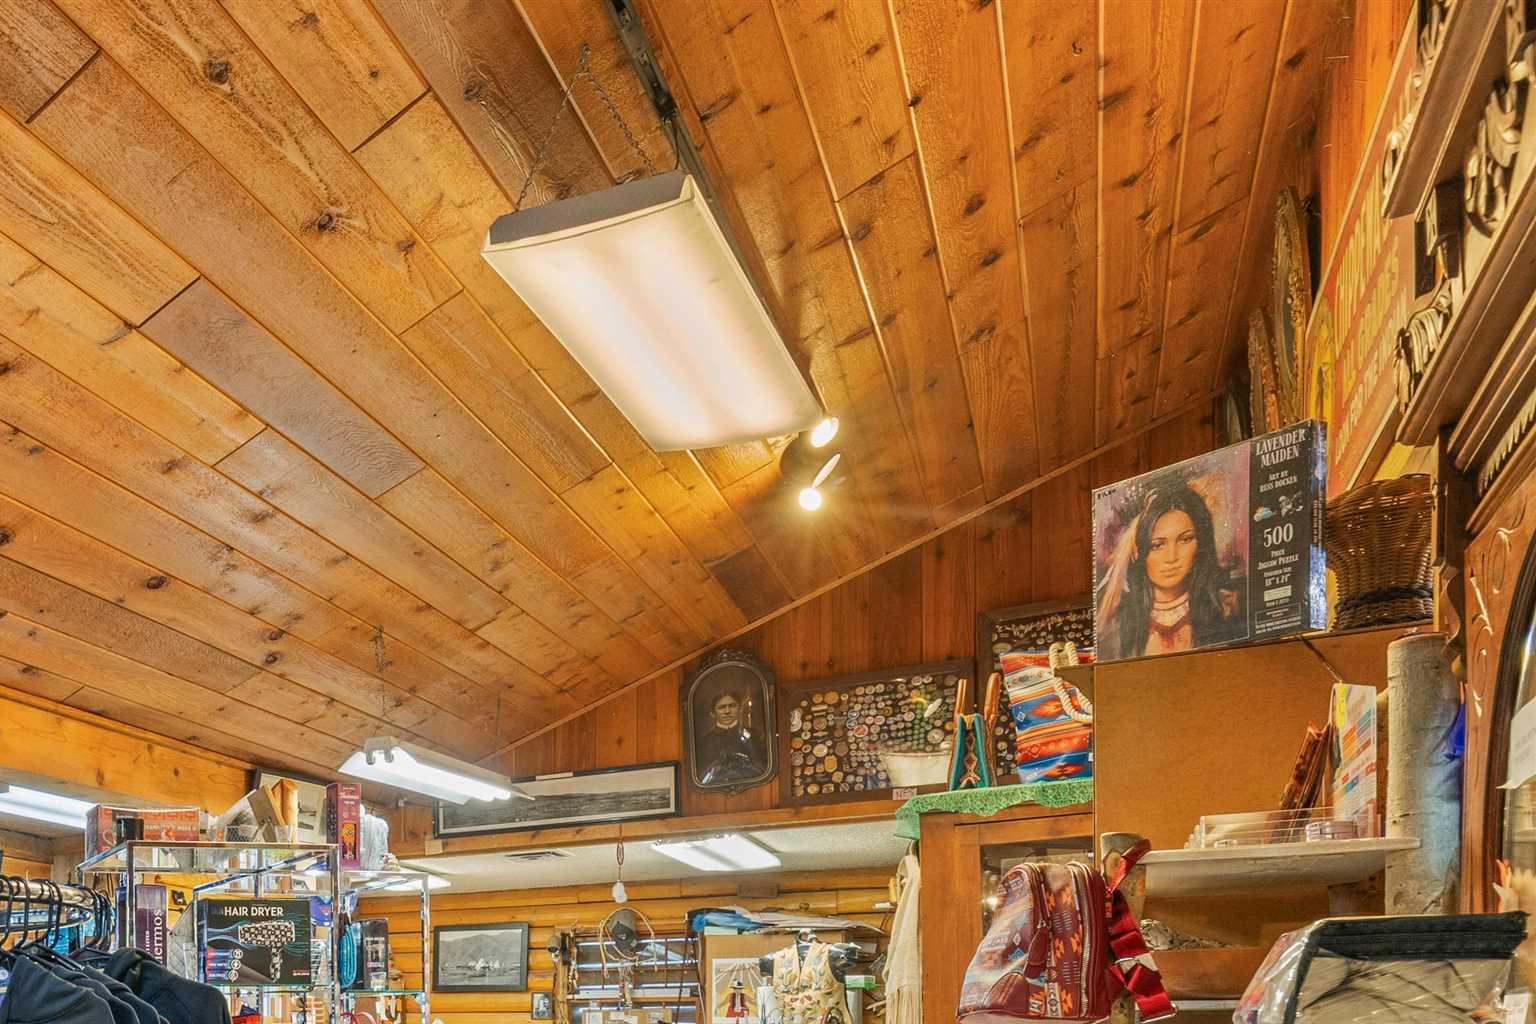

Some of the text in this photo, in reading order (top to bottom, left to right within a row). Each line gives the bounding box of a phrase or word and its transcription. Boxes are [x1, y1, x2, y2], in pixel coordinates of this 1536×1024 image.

[1256, 428, 1306, 456] LAVENDER
[1261, 444, 1300, 468] MAIDEN
[1263, 523, 1294, 548] 500
[224, 906, 284, 917] HAIR DRYER
